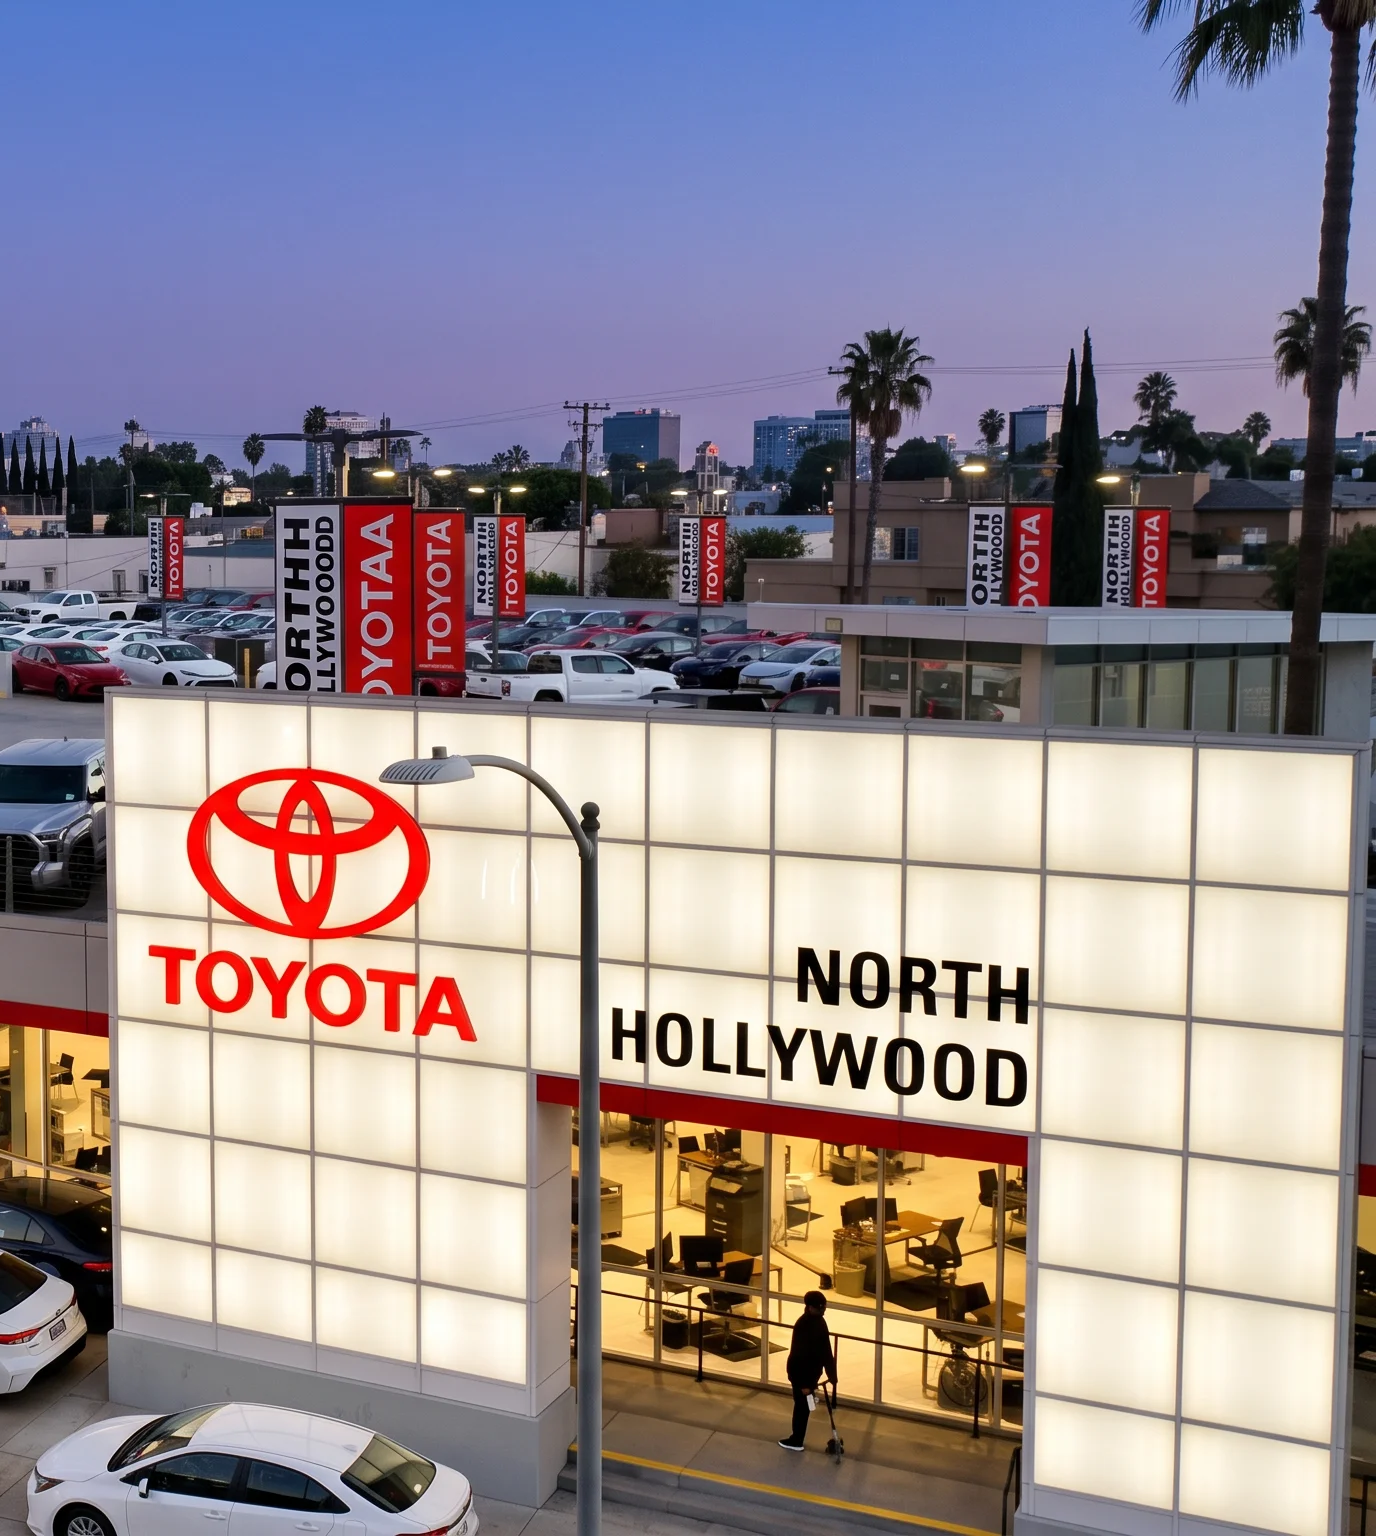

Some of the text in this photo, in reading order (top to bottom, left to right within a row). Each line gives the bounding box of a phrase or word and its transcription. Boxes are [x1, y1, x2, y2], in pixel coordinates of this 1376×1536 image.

[169, 521, 179, 592] TOYOTA
[426, 518, 451, 660] TOYOTA
[505, 521, 518, 609] TOYOTA
[706, 522, 719, 599] TOYOTA
[1142, 514, 1160, 608] TOYOTA
[149, 945, 478, 1043] TOYOTA
[798, 947, 1029, 1025] NORTH
[611, 1007, 1029, 1107] HOLLYWOOD
